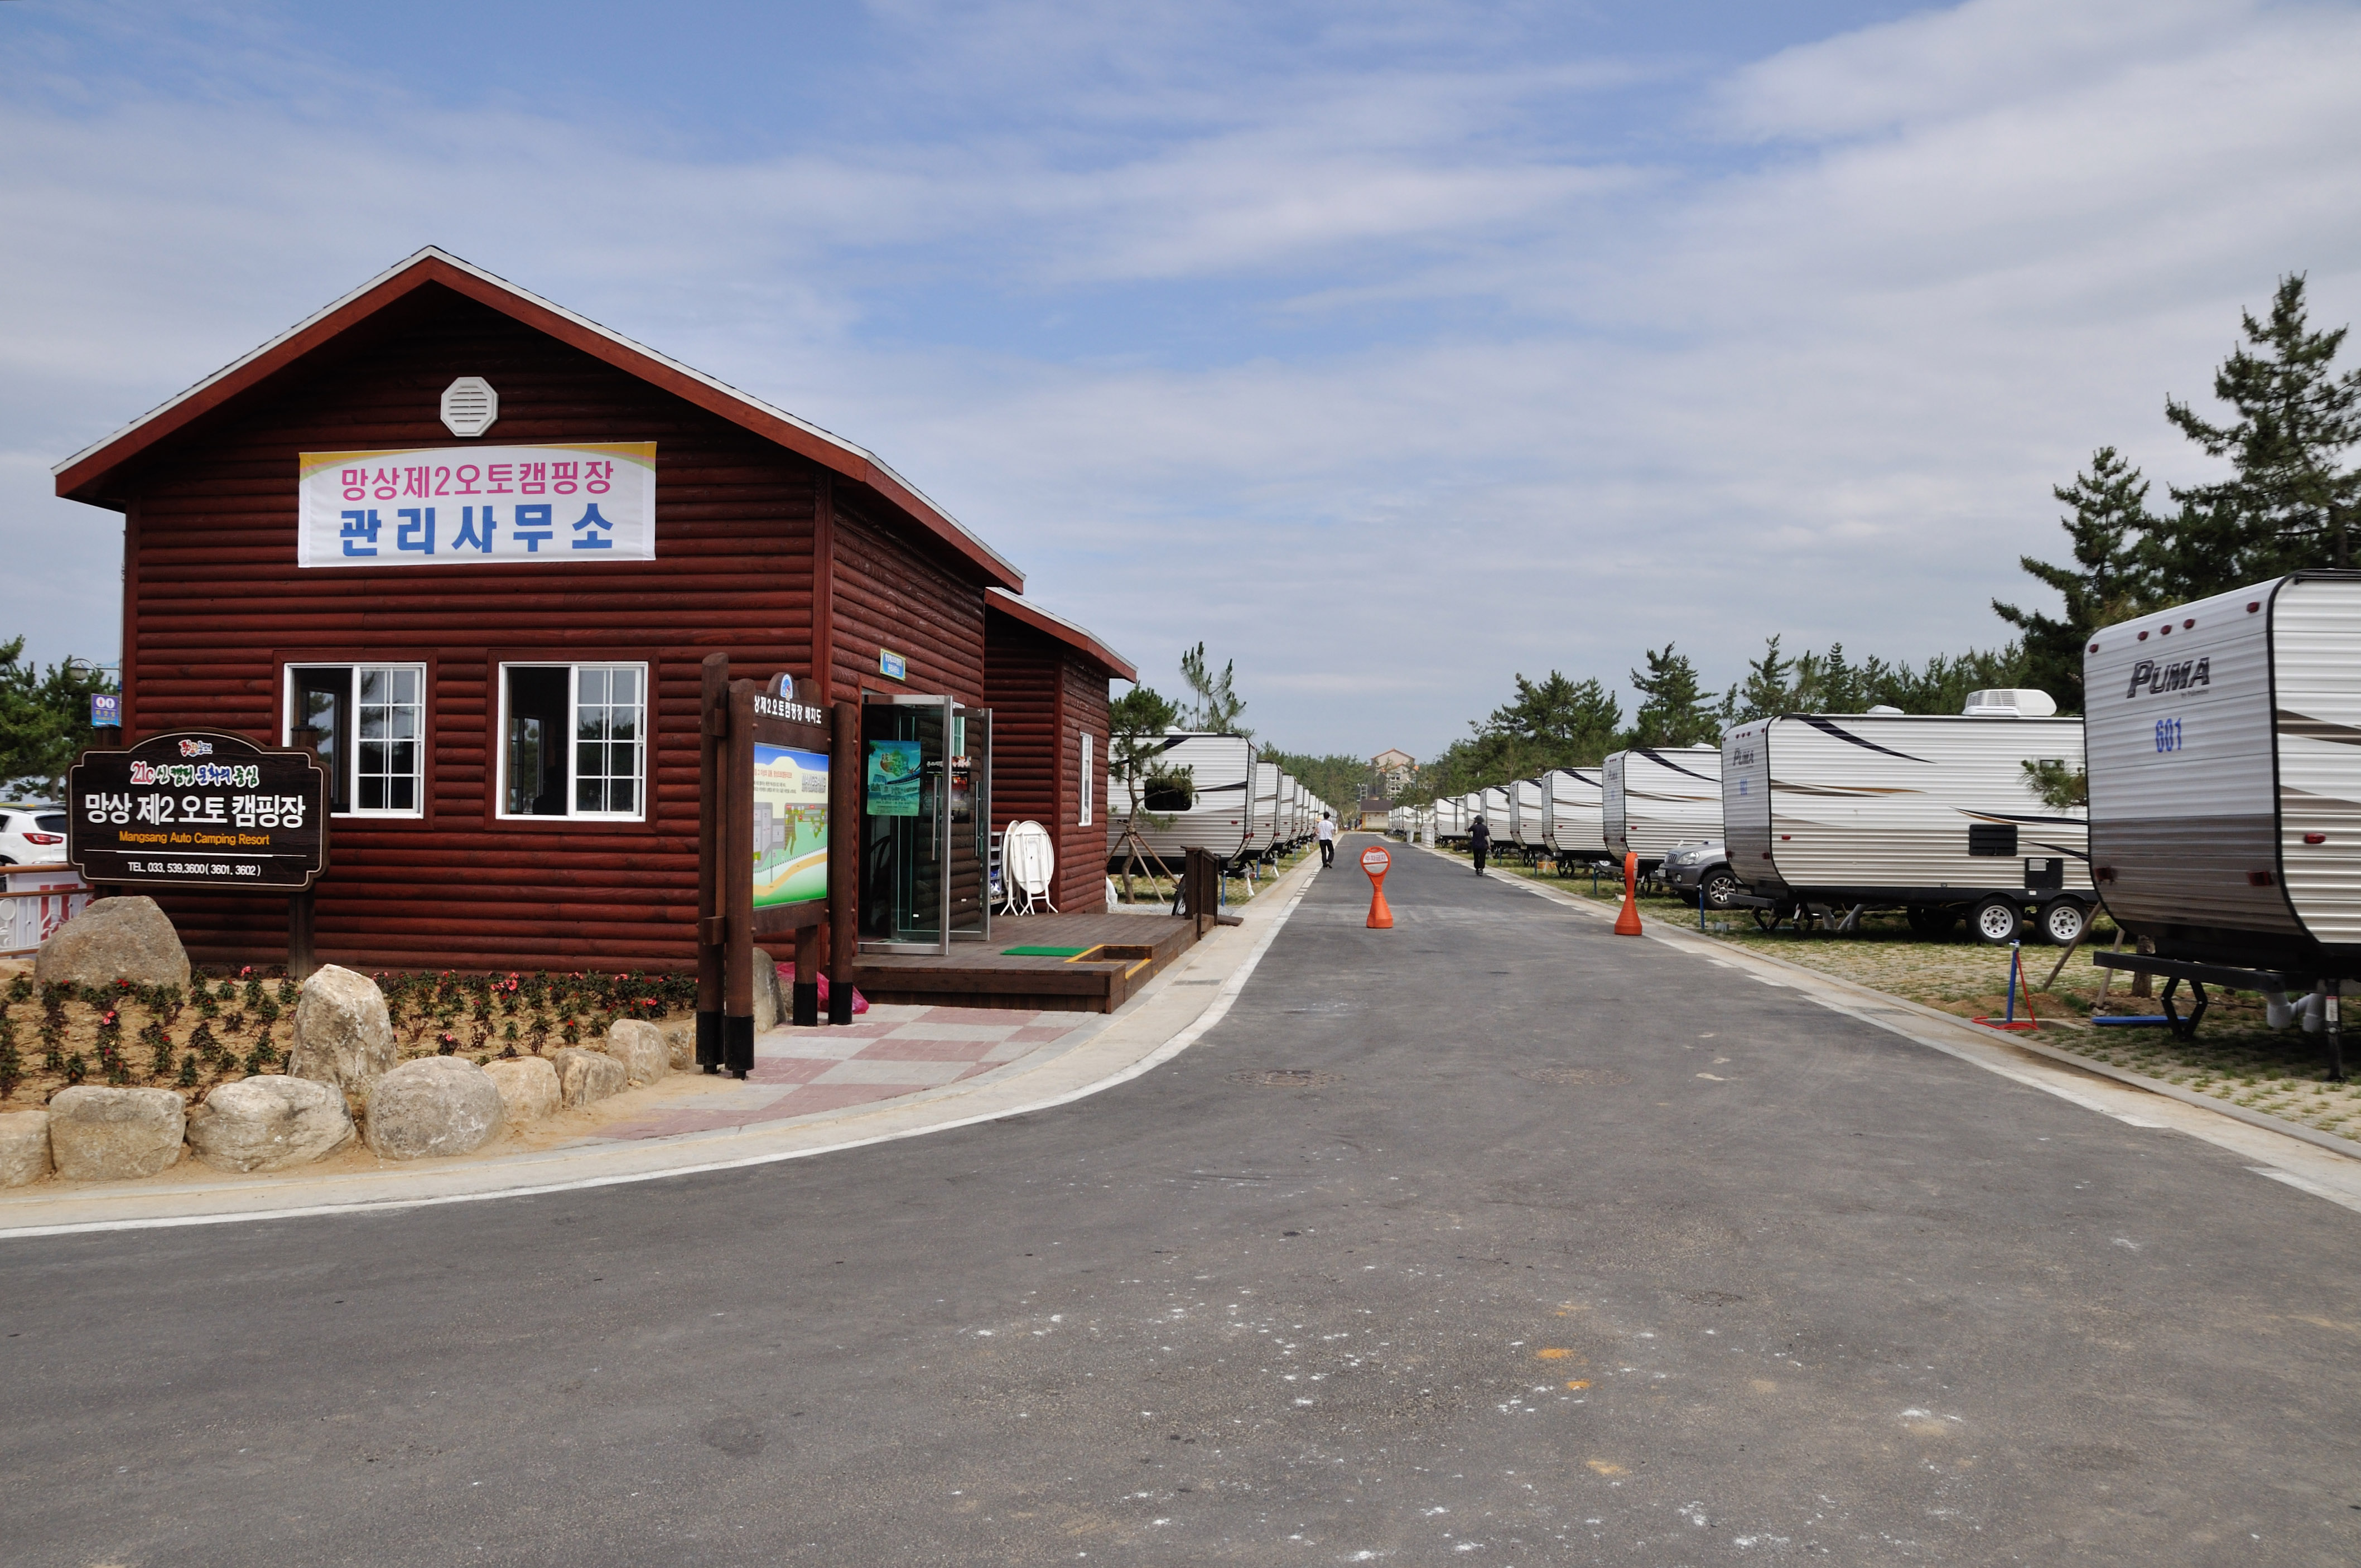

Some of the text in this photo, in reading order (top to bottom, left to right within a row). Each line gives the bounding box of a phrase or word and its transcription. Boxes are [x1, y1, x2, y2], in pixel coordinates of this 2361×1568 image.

[341, 461, 614, 501] 망상제2오토캠핑장
[339, 503, 614, 557] 관리사무소
[2127, 657, 2210, 699] PUMA
[754, 695, 822, 724] 상제2오토캠핑장 배치도
[2156, 717, 2182, 753] 601
[131, 761, 156, 784] 21c
[156, 765, 169, 784] 신
[196, 763, 232, 786] 문화의
[233, 765, 259, 787] 중심
[85, 793, 306, 828] 망상 제2 오토 캠핑장
[119, 831, 270, 846] Mangsang Auto Camping Resort
